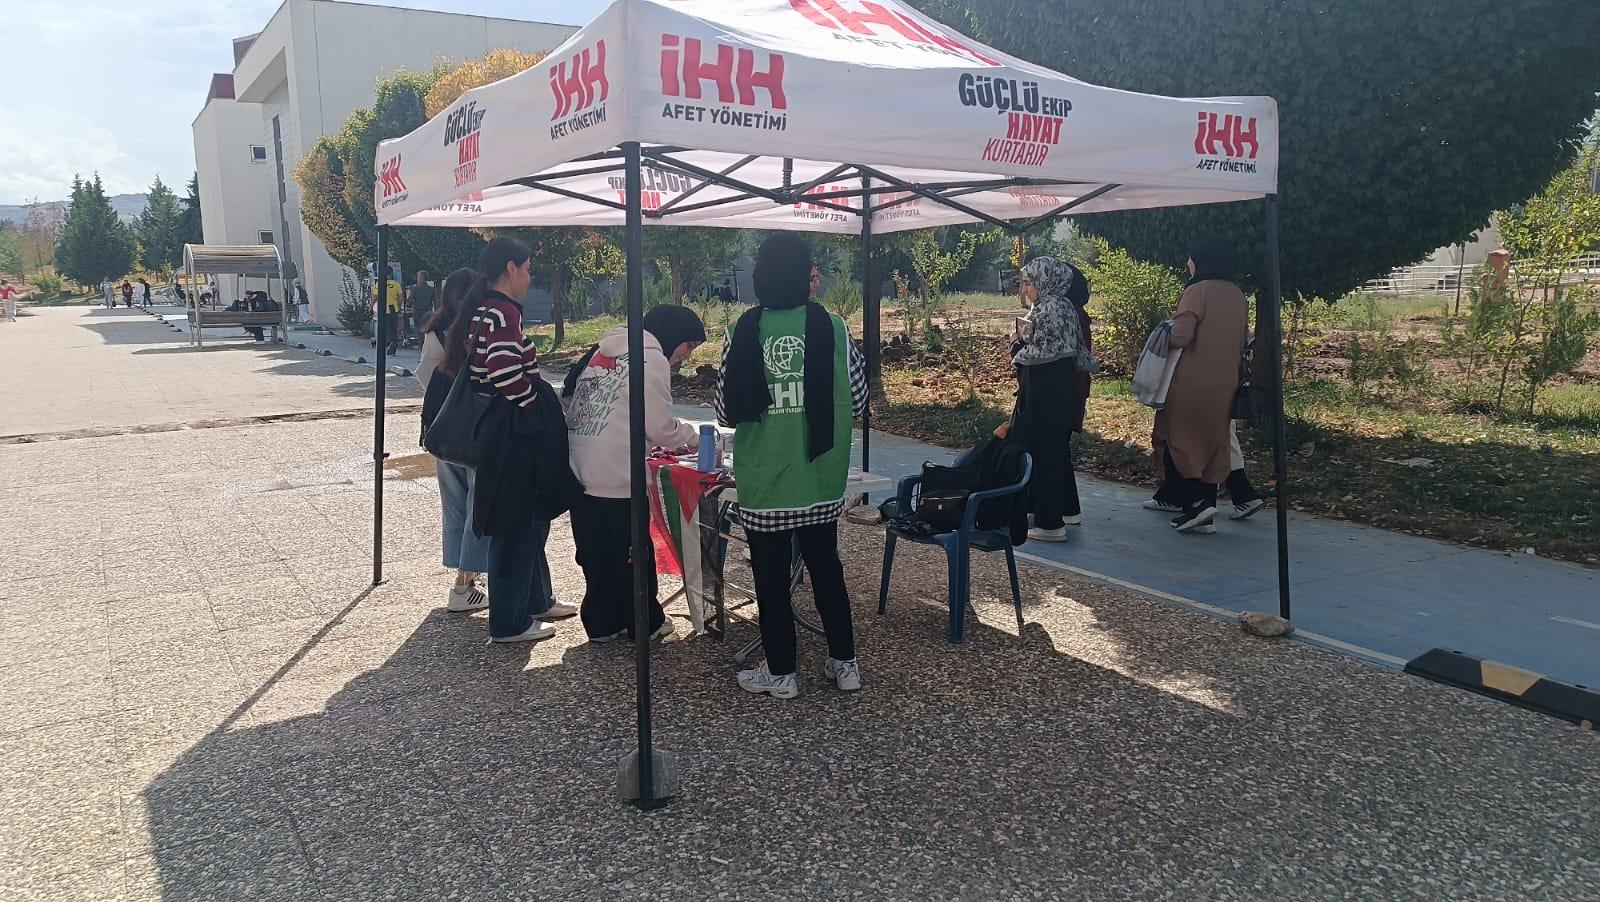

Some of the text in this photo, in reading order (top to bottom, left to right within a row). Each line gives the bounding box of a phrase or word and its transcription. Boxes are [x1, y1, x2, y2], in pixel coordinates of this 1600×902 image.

[660, 33, 787, 110] İHH
[959, 73, 1073, 118] GÜÇLÜ EKİP
[443, 101, 477, 147] GÜÇLÜ
[550, 102, 607, 140] AFET YÖNETİMİ
[661, 102, 787, 131] AFET YÖNETİMİ
[1006, 112, 1064, 145] HAYAT
[458, 131, 480, 166] HAYAT
[981, 138, 1049, 167] KURTARIR
[1194, 111, 1259, 159] İHH
[1196, 158, 1257, 174] AFET YÖNETİMİ
